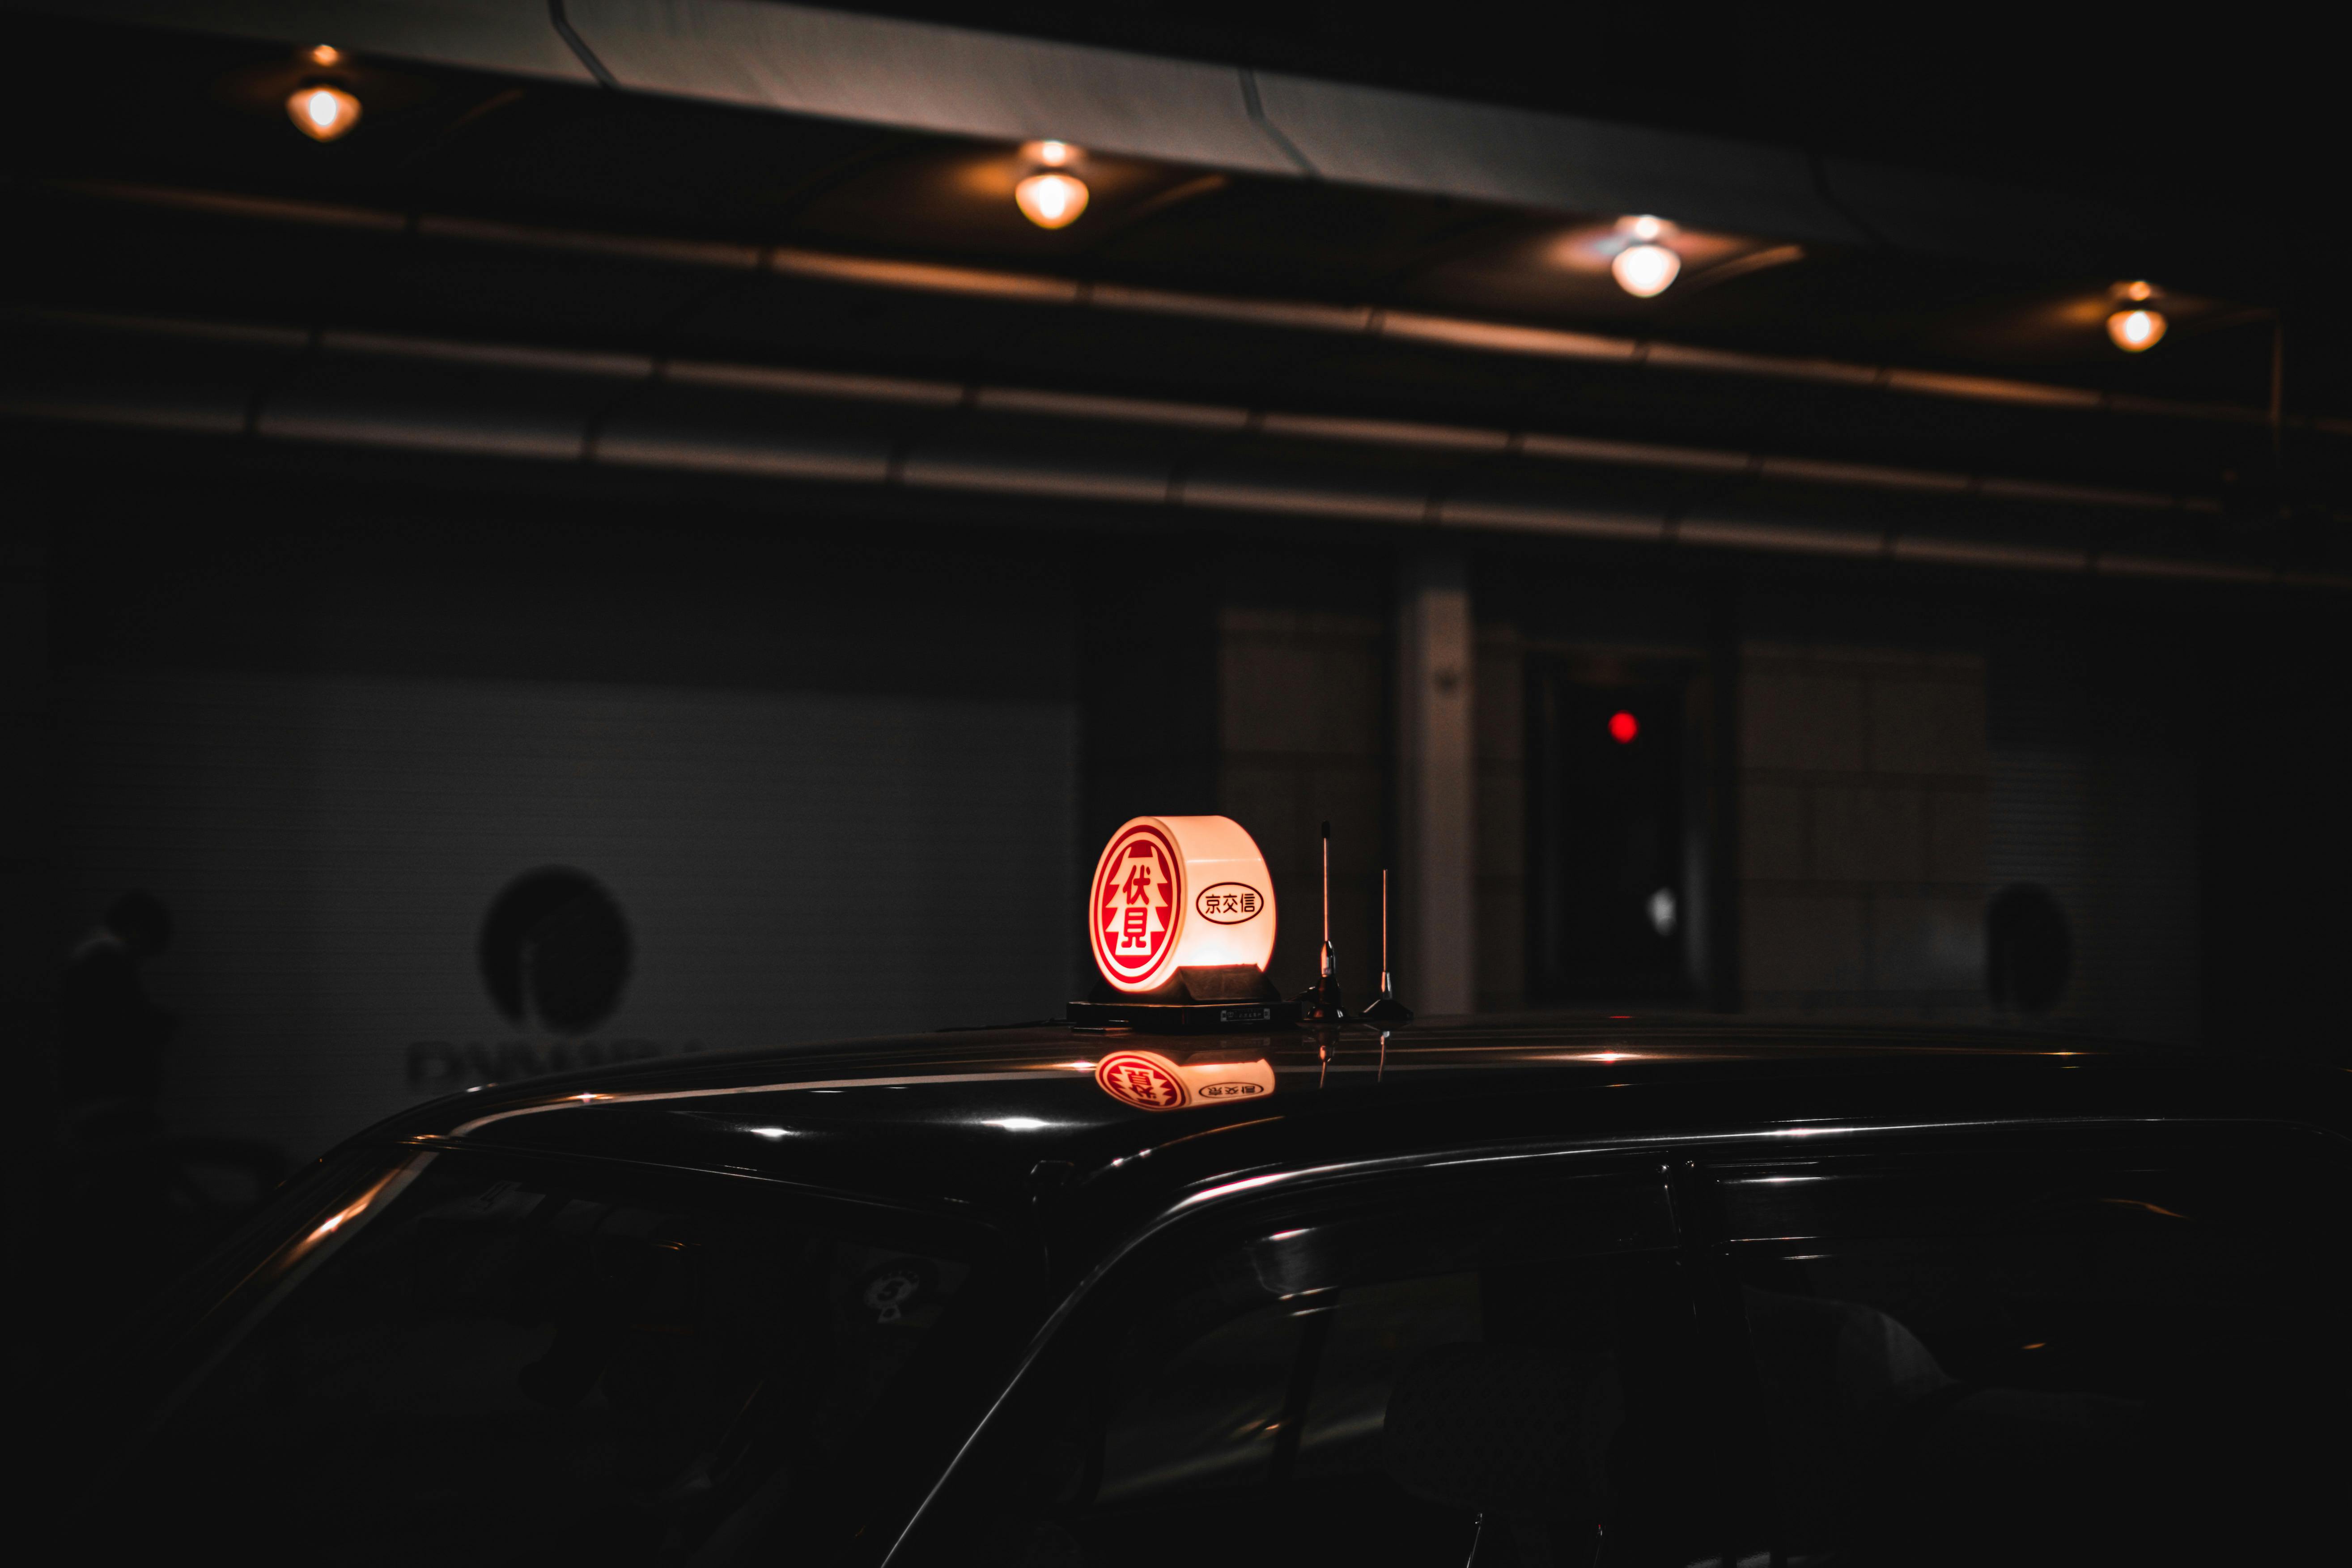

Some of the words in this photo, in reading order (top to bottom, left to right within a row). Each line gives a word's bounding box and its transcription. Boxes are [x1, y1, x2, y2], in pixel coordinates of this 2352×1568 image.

[1121, 864, 1151, 948] 伏見
[1205, 893, 1255, 914] 京交信
